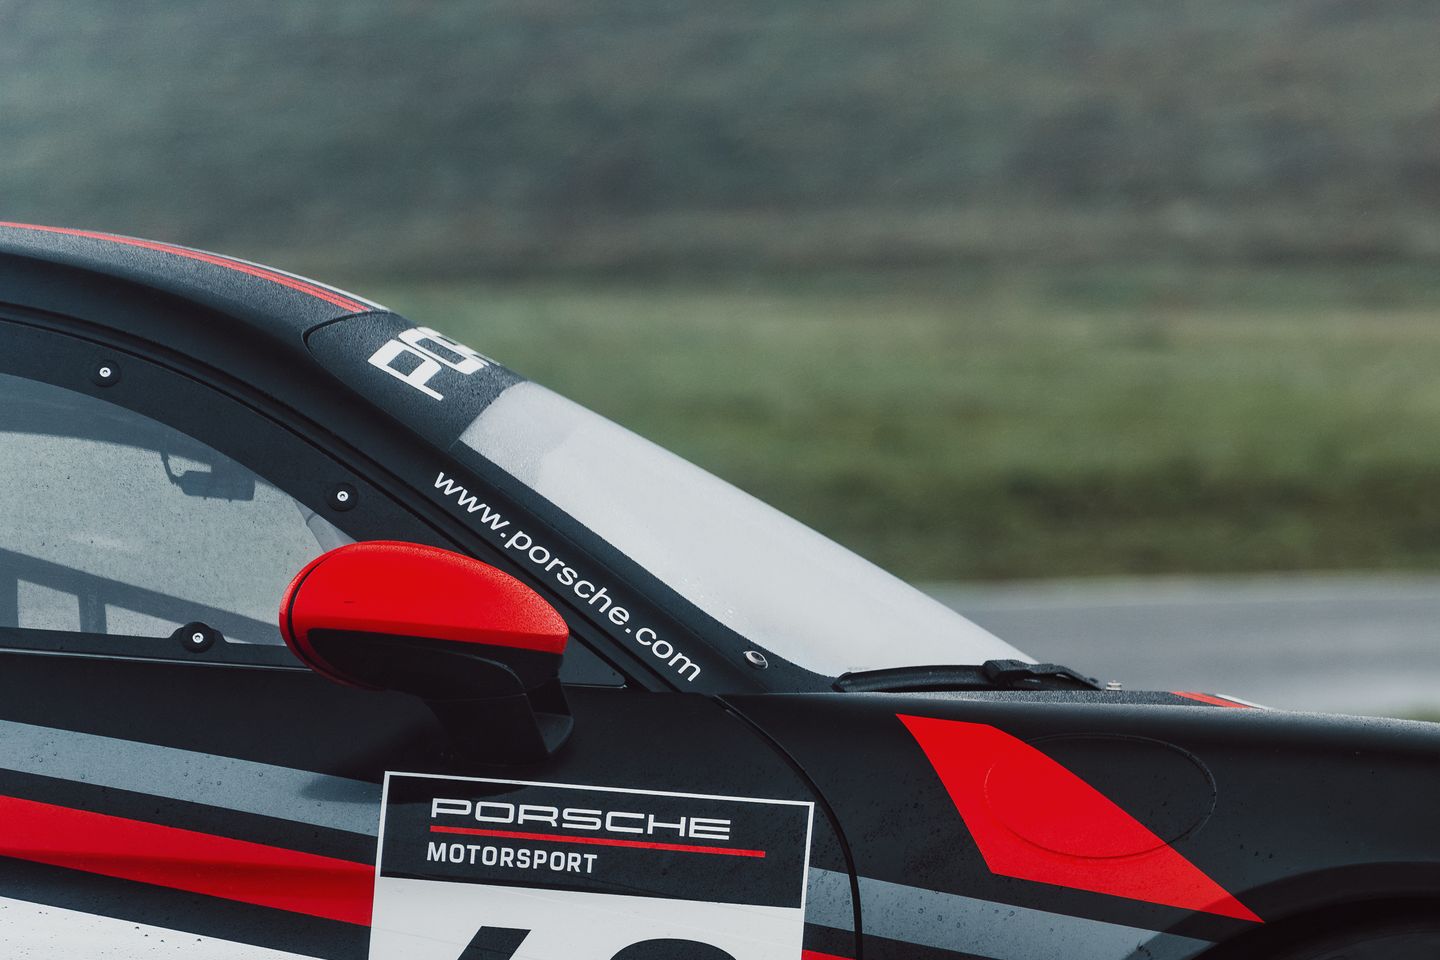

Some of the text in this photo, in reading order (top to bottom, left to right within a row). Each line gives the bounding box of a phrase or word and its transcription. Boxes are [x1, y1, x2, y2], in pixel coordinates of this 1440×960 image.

[433, 470, 702, 682] www.porsche.com
[429, 797, 732, 841] PORSCHE
[426, 841, 598, 875] MOTORSPORT
